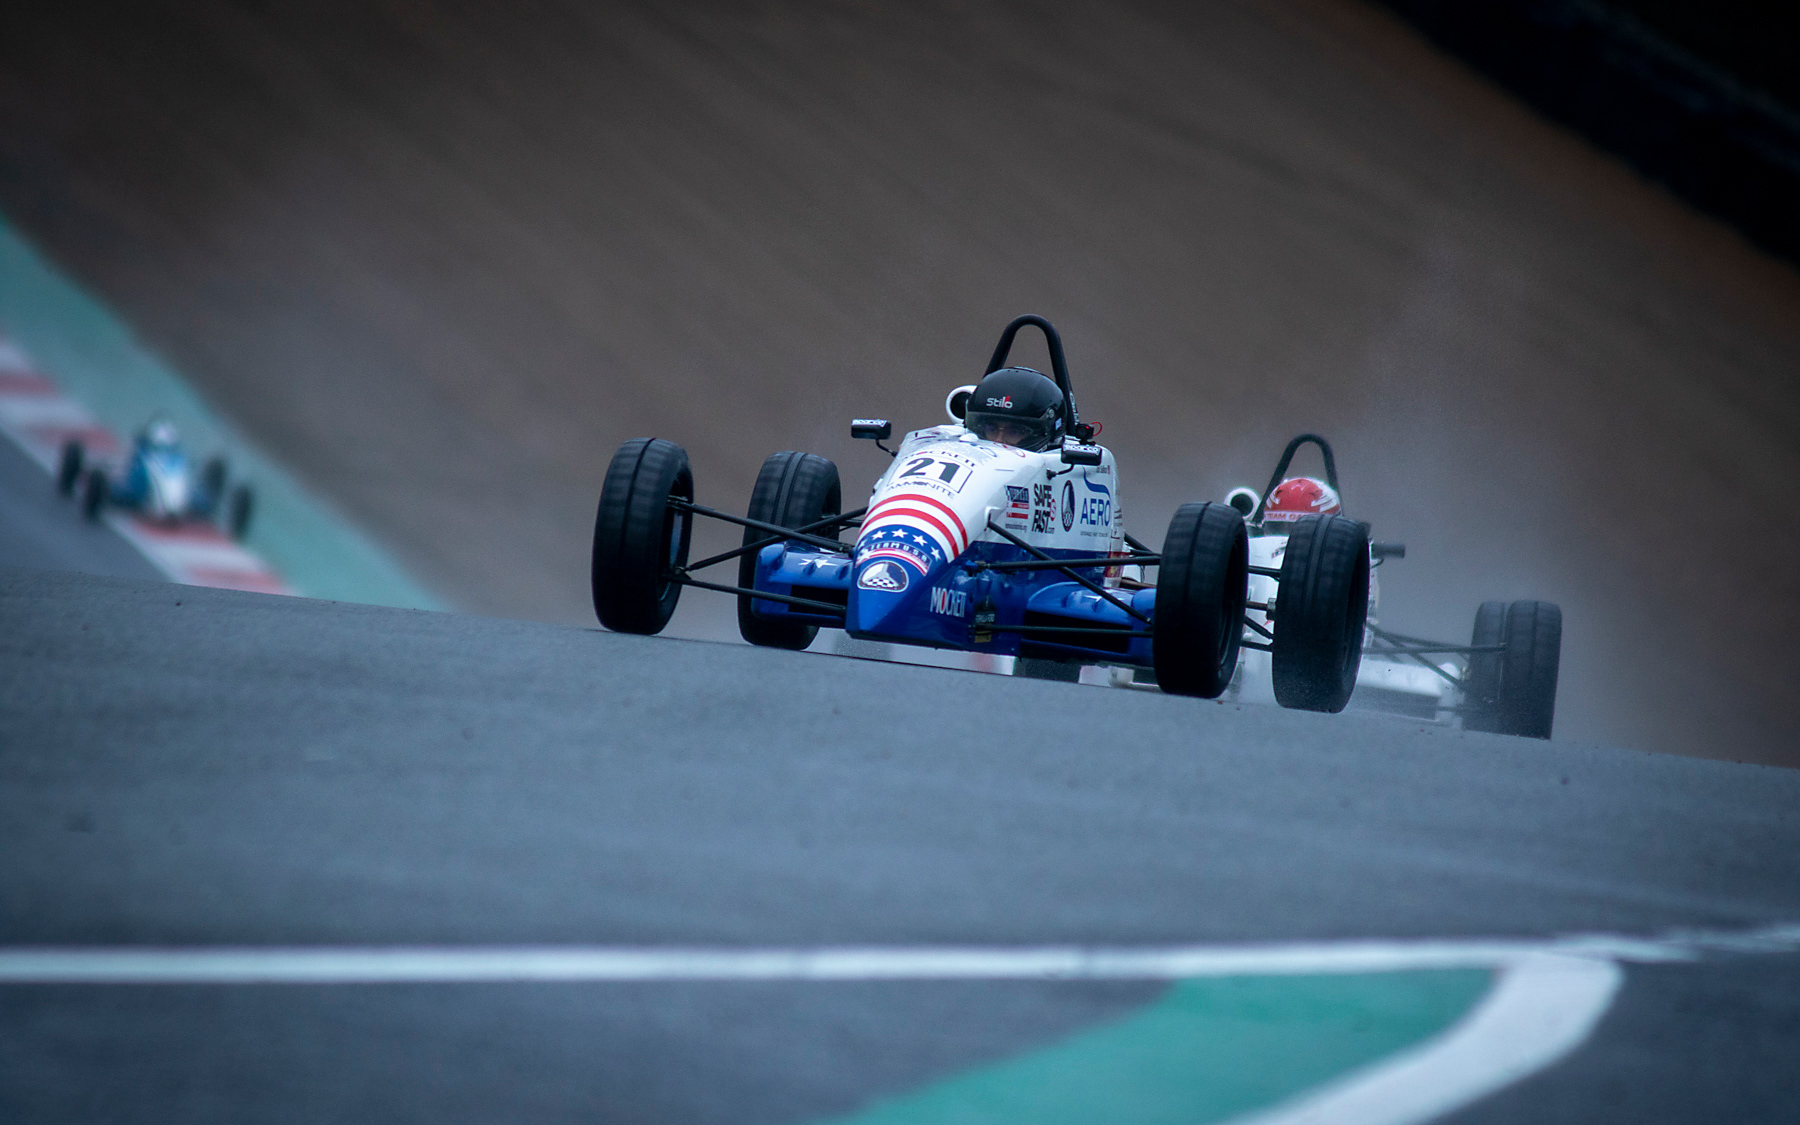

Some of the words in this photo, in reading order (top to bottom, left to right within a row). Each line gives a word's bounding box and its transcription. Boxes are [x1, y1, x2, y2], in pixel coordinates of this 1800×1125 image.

[986, 396, 1013, 409] Stilo
[899, 457, 960, 484] 21
[1033, 483, 1053, 508] SAFE
[1080, 498, 1111, 527] AERO
[871, 542, 900, 551] TEAM
[930, 587, 967, 617] MOCKETT
